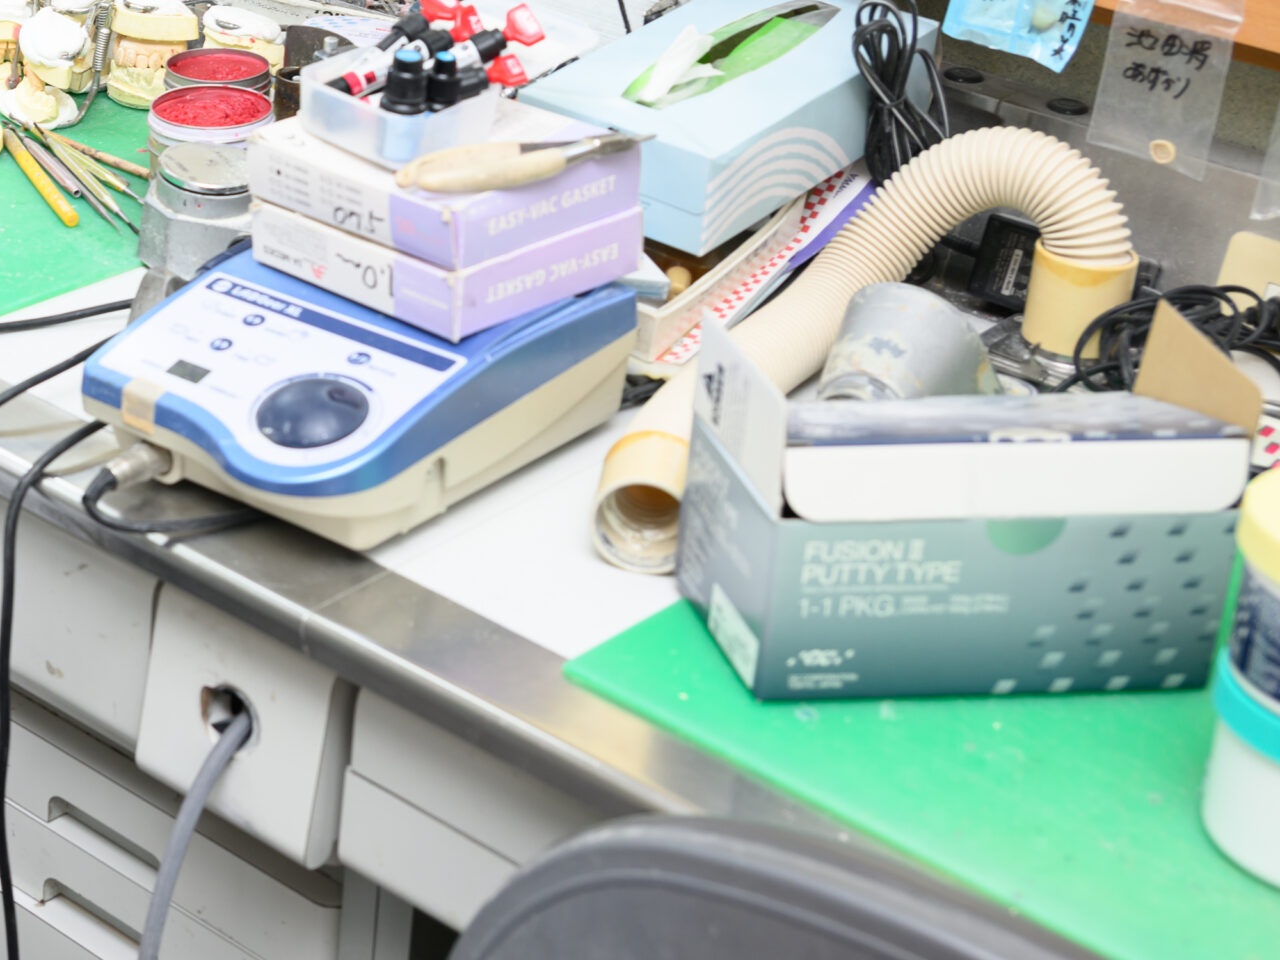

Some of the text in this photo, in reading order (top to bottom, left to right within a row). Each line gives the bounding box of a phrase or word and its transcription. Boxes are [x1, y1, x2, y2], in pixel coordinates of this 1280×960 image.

[487, 174, 617, 237] EASY-VAC GASKET
[486, 243, 619, 304] EASY-VAC GASKET
[803, 540, 904, 563] FUSION
[800, 560, 963, 585] PUTTY TYPE
[799, 597, 833, 618] 1-1
